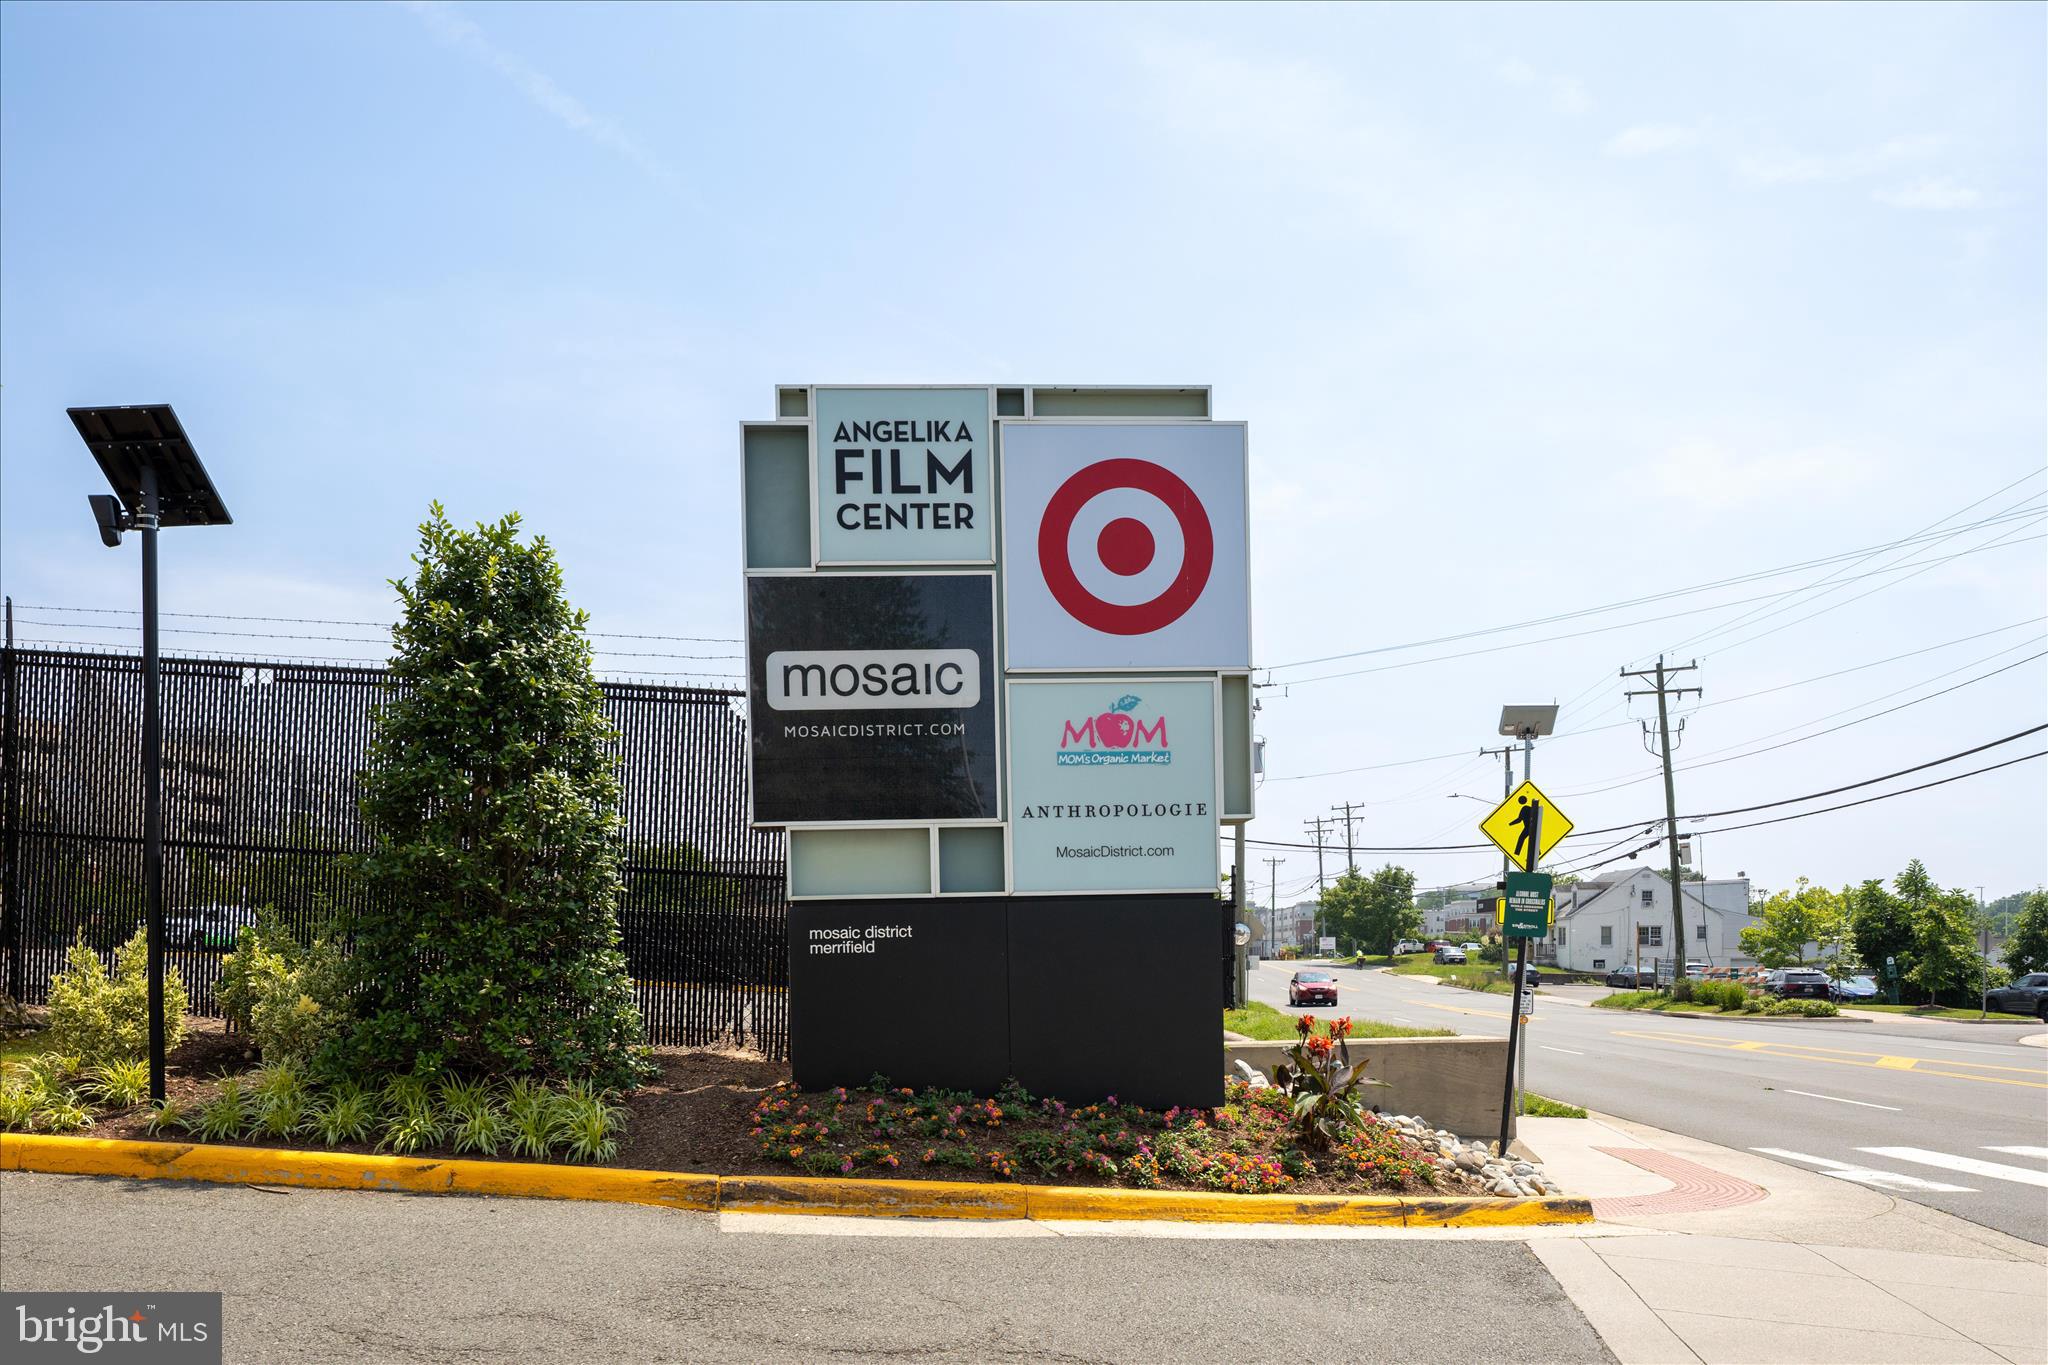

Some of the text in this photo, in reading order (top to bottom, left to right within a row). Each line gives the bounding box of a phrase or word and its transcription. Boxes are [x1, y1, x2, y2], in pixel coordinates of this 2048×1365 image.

[833, 420, 974, 443] ANGELIKA
[835, 448, 974, 494] FILM
[836, 503, 974, 530] CENTER
[783, 662, 964, 697] mosaic
[784, 723, 966, 738] MOSAICDISTRICT.COM
[1060, 712, 1169, 749] MOM
[1091, 753, 1129, 765] Organic
[1130, 751, 1170, 763] Market
[1021, 803, 1207, 818] ANTHROPOLOGIE
[1056, 845, 1175, 858] MosaicDistrict.com
[809, 924, 913, 940] mosaic district
[809, 940, 876, 955] merrifield
